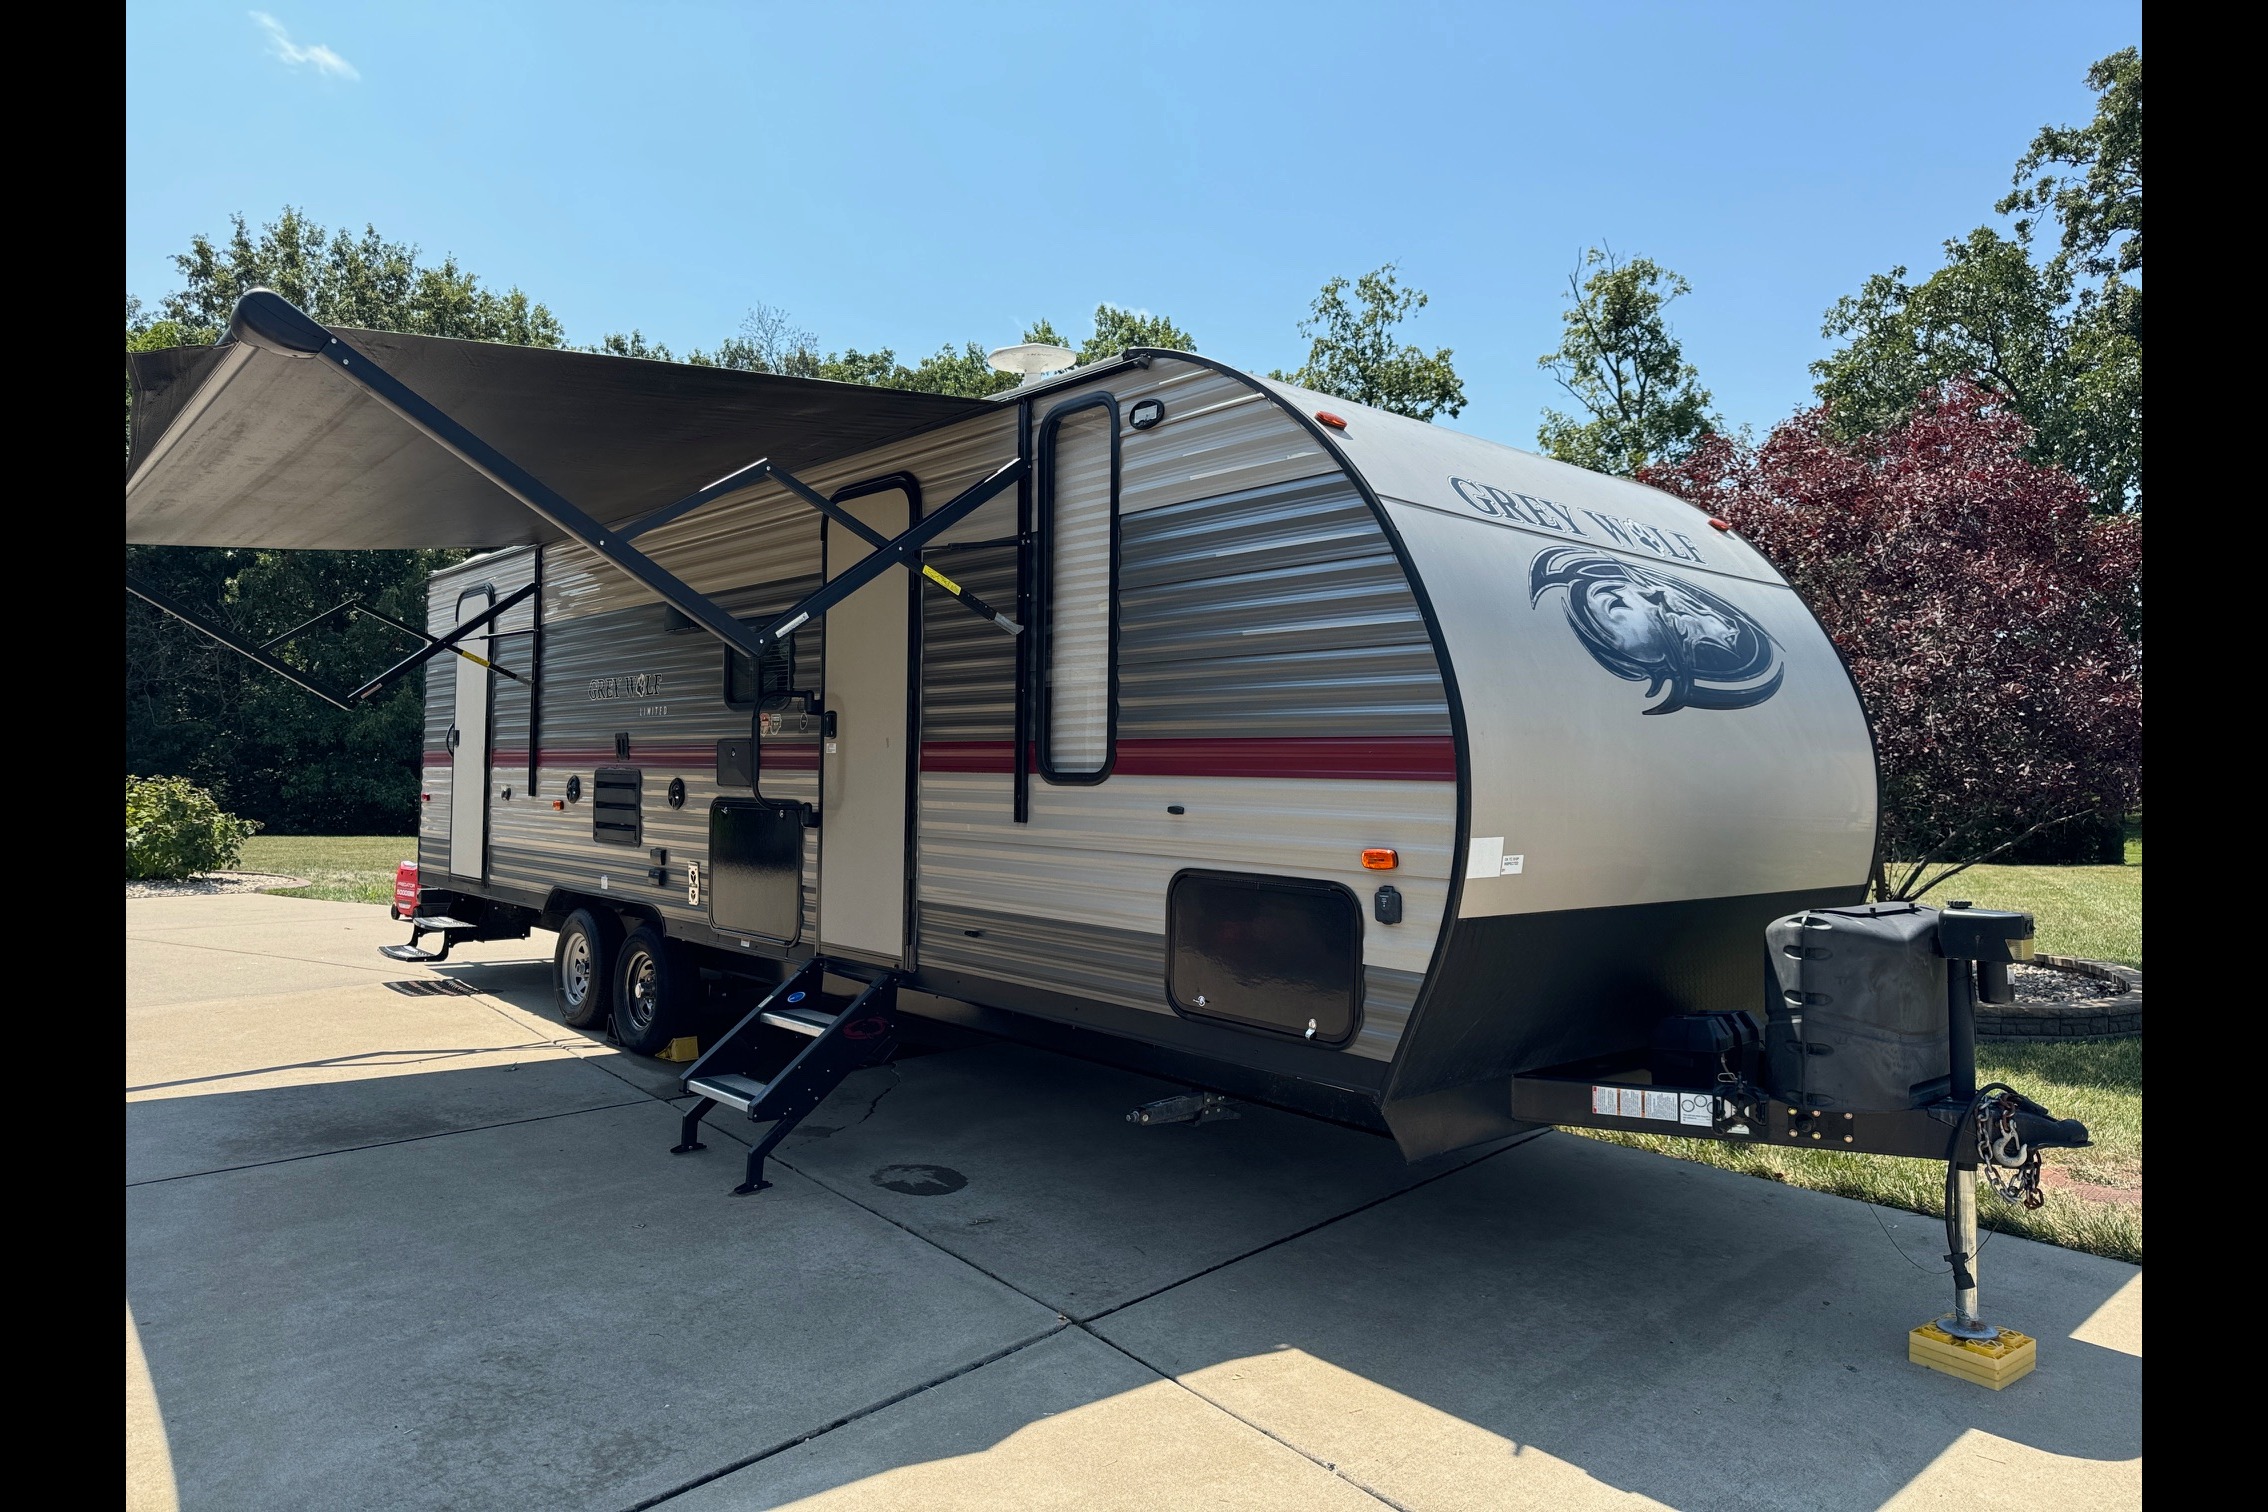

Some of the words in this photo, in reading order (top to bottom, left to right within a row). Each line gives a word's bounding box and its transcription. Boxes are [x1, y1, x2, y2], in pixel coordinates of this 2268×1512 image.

[1448, 475, 1591, 538] GREY
[588, 678, 622, 700] GREY
[640, 706, 667, 716] LIMITED
